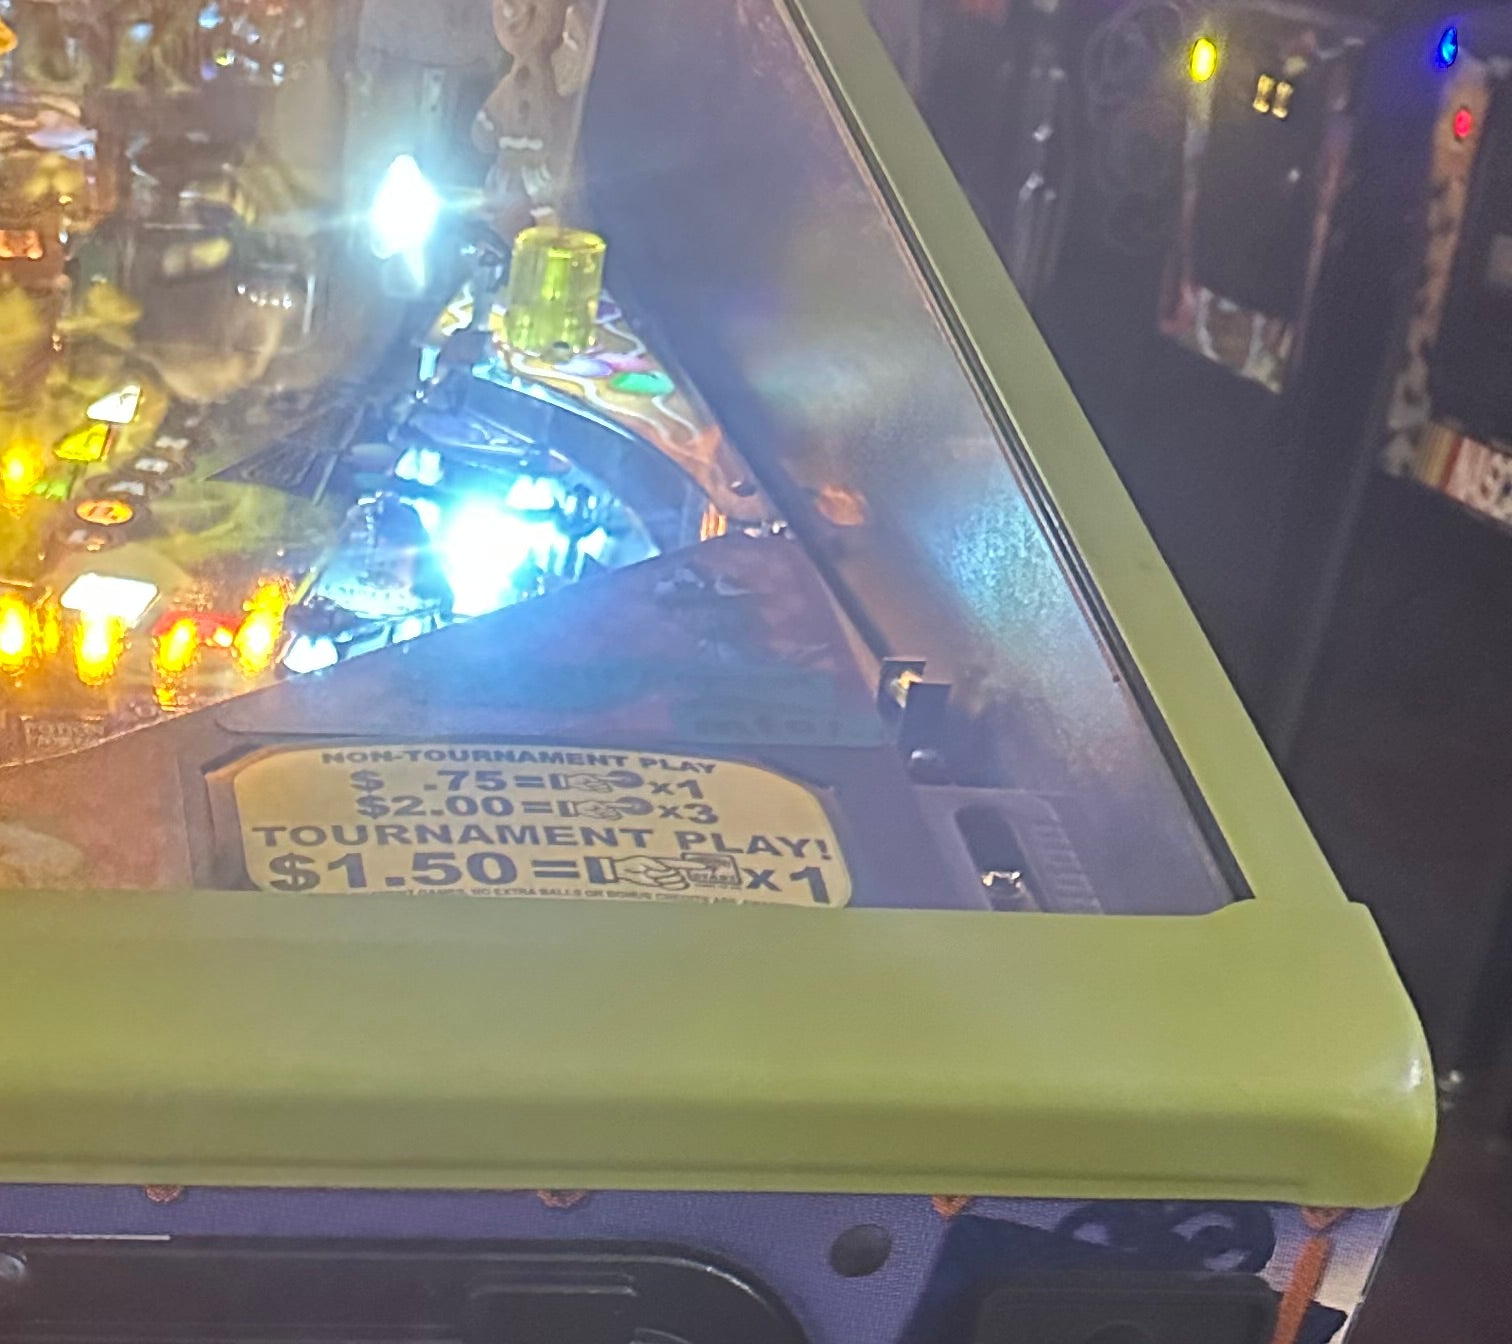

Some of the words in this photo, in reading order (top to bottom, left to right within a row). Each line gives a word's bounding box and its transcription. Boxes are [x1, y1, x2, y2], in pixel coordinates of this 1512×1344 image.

[322, 749, 628, 768] NON-TOURNAMENT
[640, 756, 717, 775] PLAY
[251, 824, 654, 848] TOURNAMENT
[673, 830, 833, 861] PLAY!
